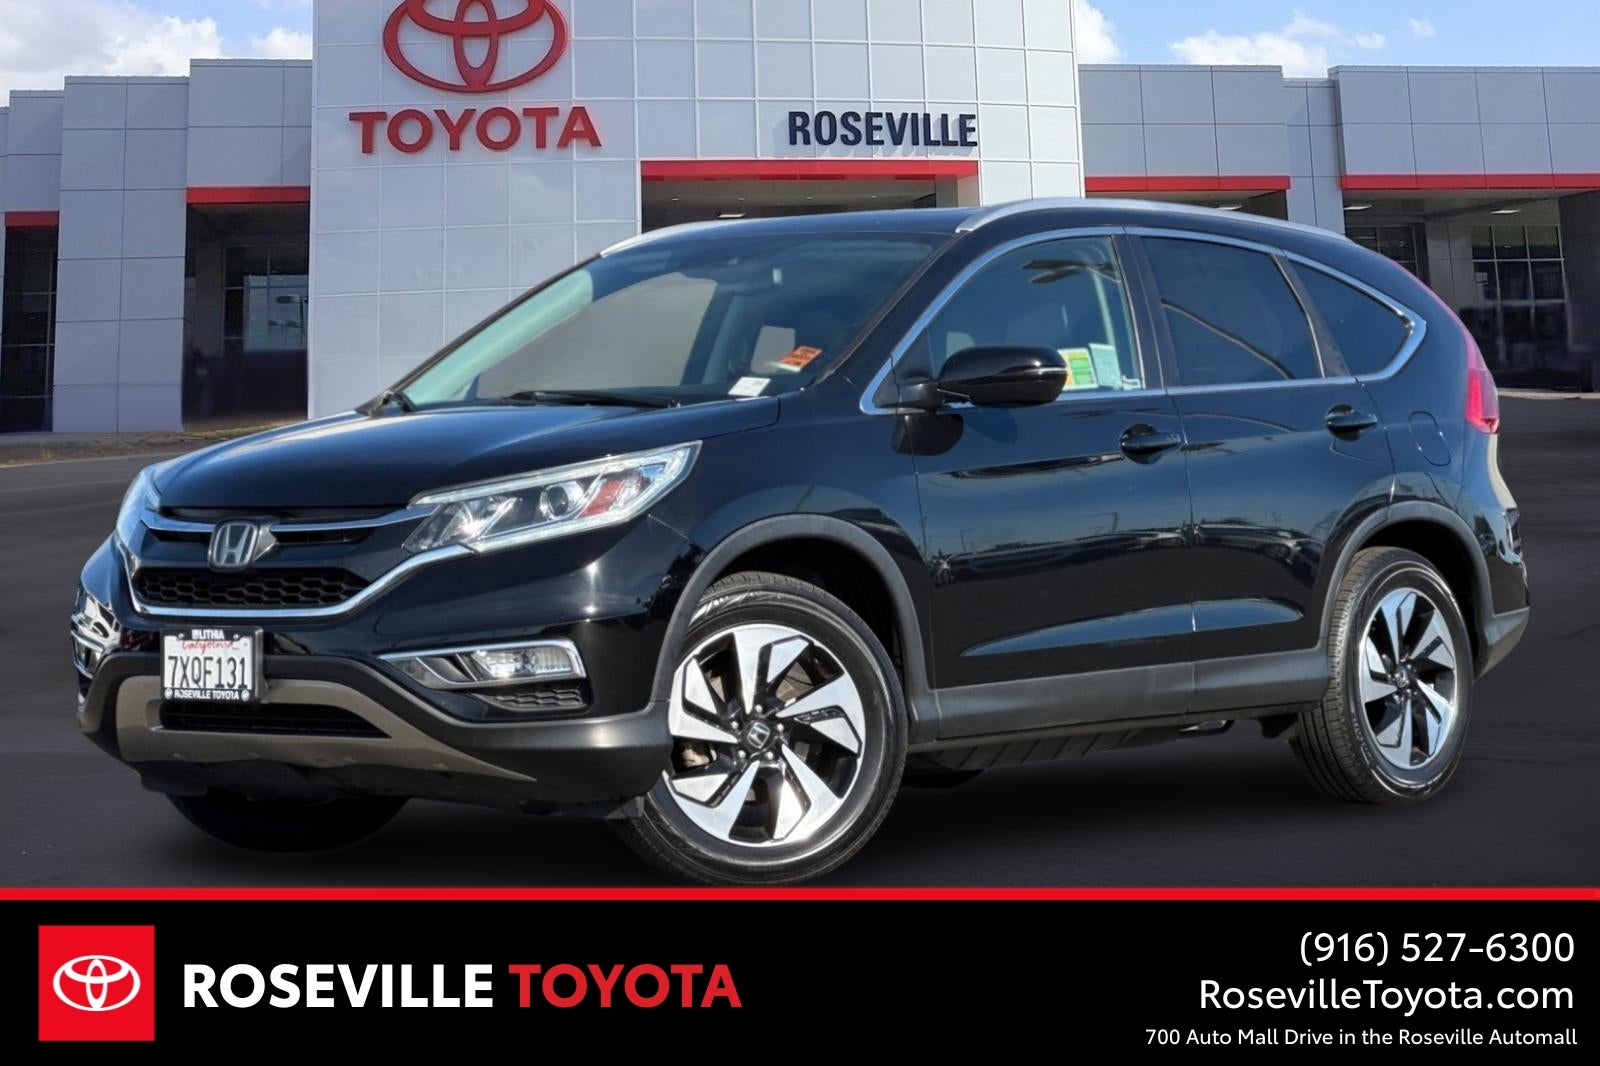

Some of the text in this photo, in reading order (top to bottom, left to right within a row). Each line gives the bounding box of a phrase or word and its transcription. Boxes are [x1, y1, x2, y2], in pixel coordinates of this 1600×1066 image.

[349, 105, 602, 154] TOYOTA
[788, 110, 978, 147] ROSEVILLE
[168, 656, 248, 689] 7XQF131
[174, 689, 240, 701] ROSEVILLE TOYOTA
